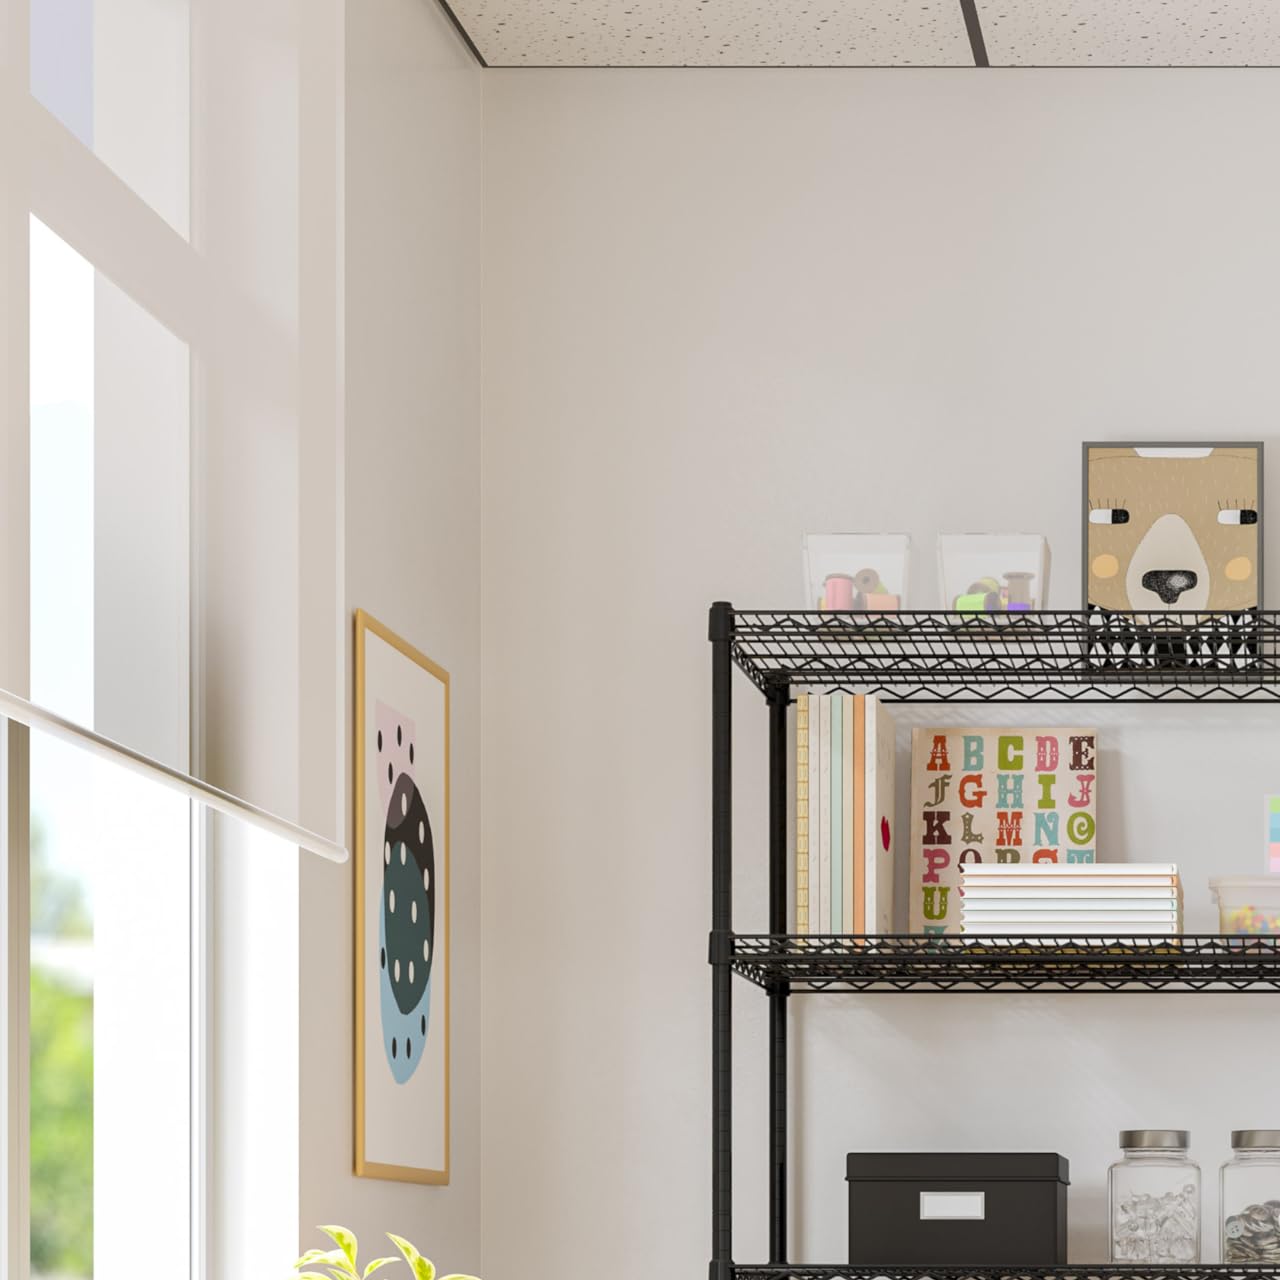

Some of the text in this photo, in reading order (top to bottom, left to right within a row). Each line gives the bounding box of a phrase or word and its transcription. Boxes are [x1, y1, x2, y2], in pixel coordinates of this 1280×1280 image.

[926, 735, 1095, 772] A B C D E
[958, 774, 988, 808] G
[995, 774, 1024, 808] H
[1037, 774, 1056, 809] I
[1067, 774, 1095, 808] J
[922, 811, 952, 845] K
[960, 812, 985, 845] L
[995, 811, 1023, 846] M
[1033, 811, 1060, 846] N
[922, 848, 950, 883] P
[922, 886, 950, 920] U
